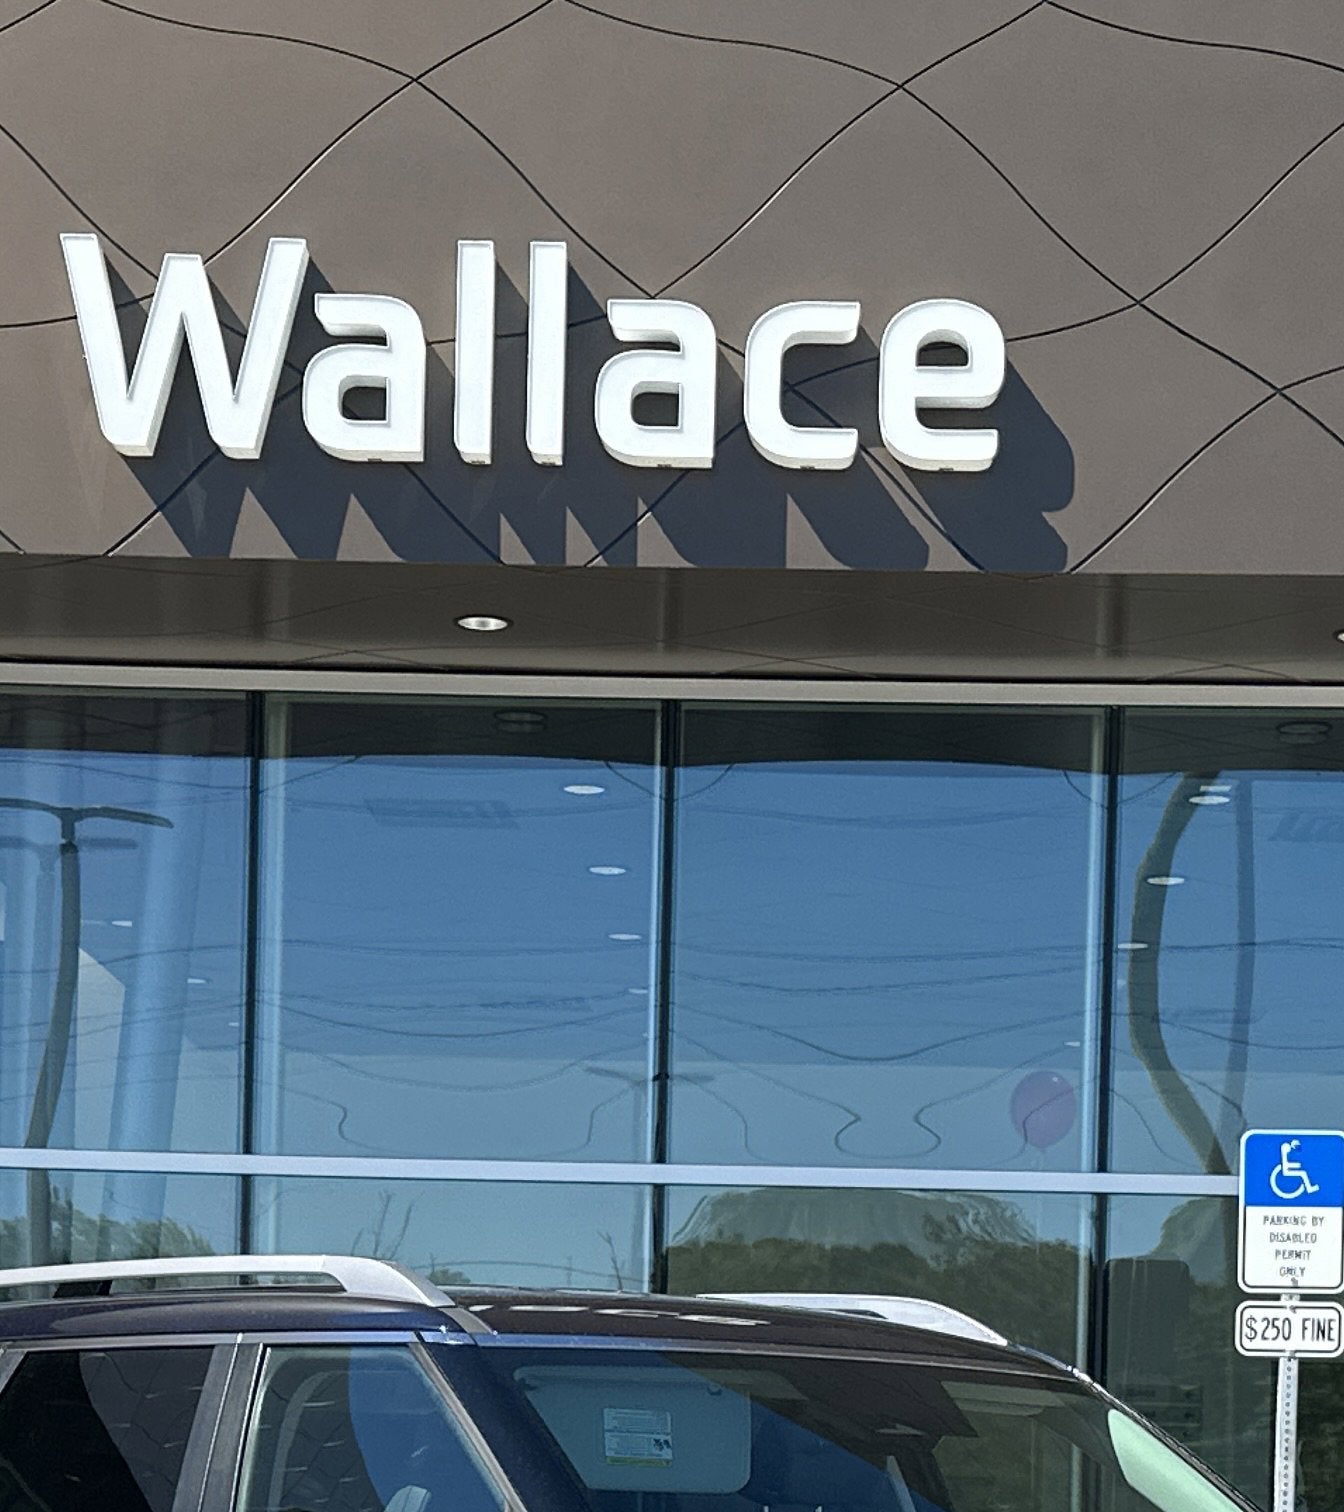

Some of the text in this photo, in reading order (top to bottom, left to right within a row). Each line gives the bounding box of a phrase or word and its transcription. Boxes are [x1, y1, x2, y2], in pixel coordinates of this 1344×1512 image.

[59, 232, 1006, 473] Wallace
[1263, 1215, 1325, 1227] PARKING BY
[1269, 1232, 1317, 1244] DISABLED
[1275, 1249, 1311, 1261] PERMIT
[1245, 1315, 1336, 1342] $250 FINE
